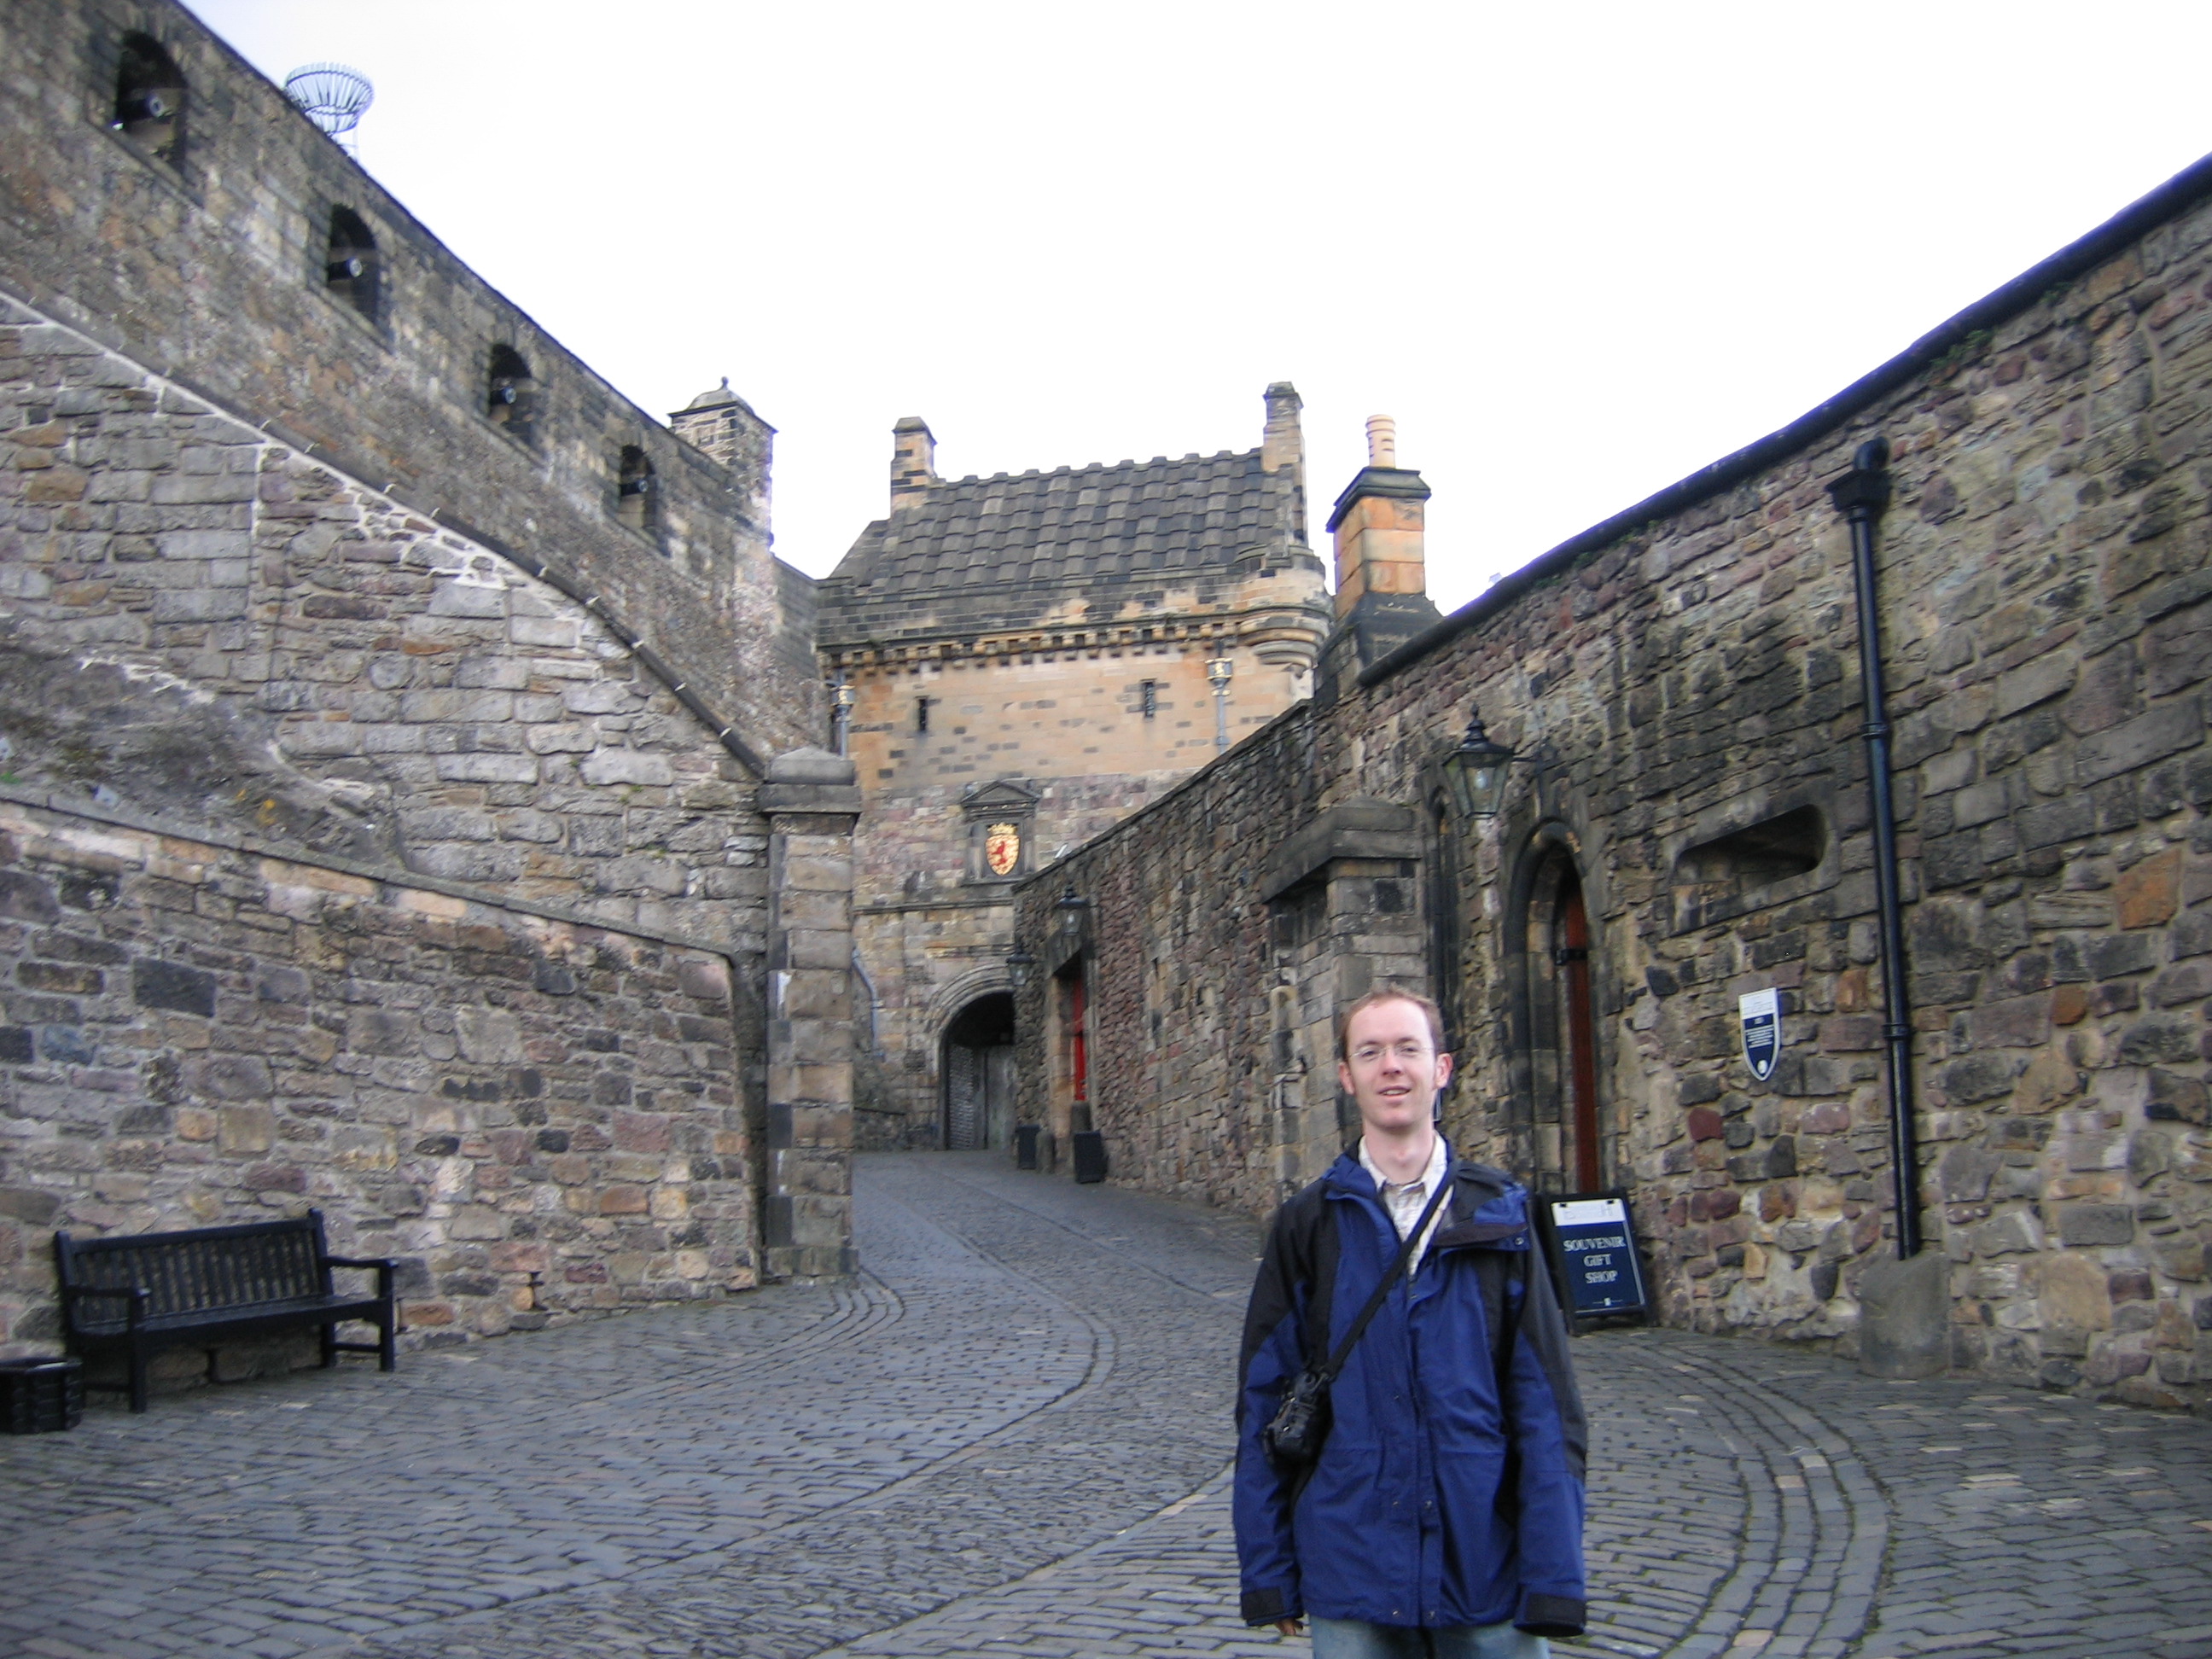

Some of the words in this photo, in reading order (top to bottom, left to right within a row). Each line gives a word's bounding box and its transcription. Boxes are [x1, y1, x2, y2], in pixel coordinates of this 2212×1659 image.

[1563, 1236, 1627, 1252] SOUVENIR
[1583, 1254, 1612, 1267] GIFT
[1585, 1270, 1618, 1284] SHOP
